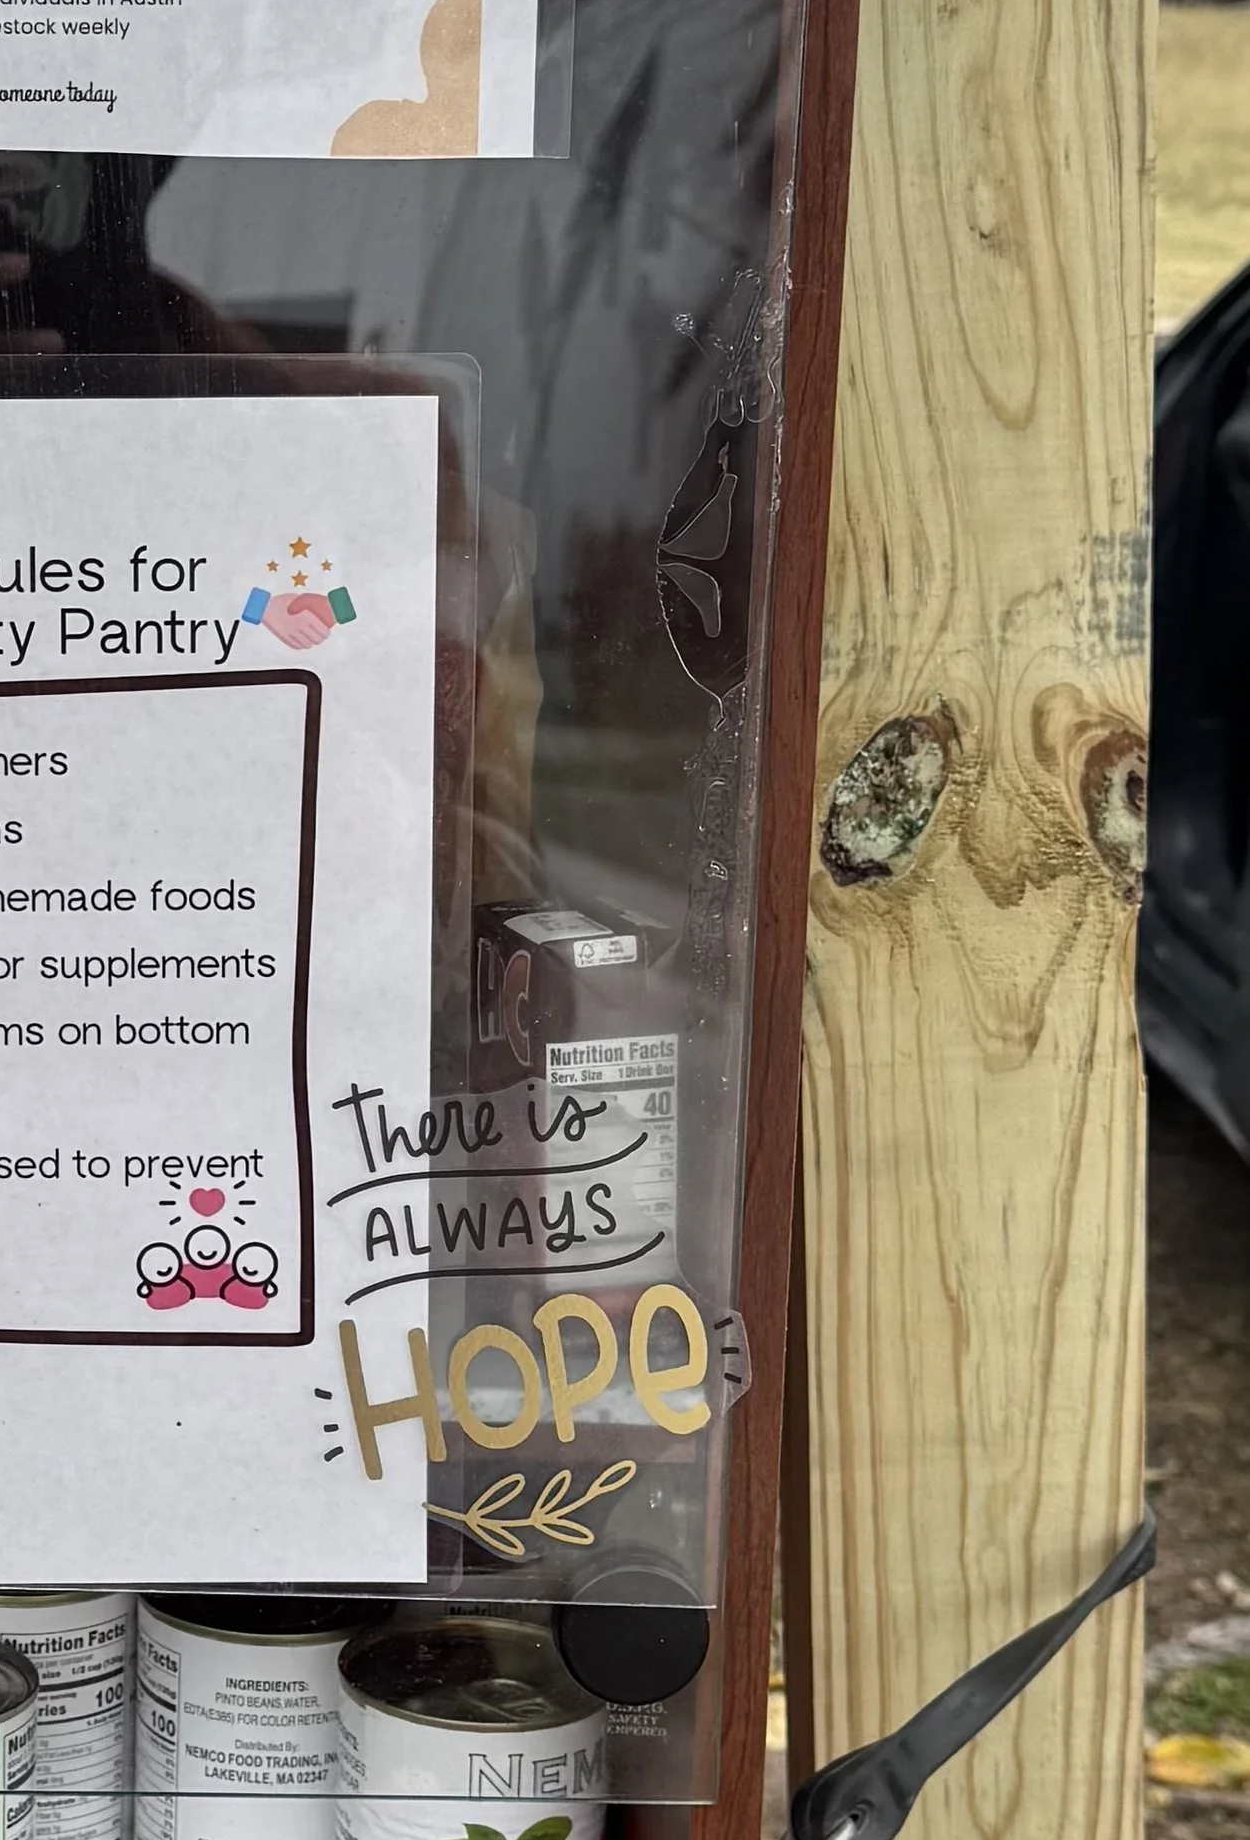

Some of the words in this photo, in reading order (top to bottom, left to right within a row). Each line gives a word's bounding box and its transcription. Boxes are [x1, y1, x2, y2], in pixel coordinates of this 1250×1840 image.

[61, 17, 131, 40] weekly
[64, 80, 118, 113] today
[130, 545, 207, 593] for
[59, 607, 241, 665] Pantry
[149, 878, 256, 911] foods
[40, 946, 277, 987] supplements
[57, 1022, 103, 1046] on
[115, 1013, 251, 1046] bottom
[549, 1043, 625, 1067] Nutrition
[629, 1039, 674, 1059] Facts
[550, 1070, 579, 1085] Serv.
[580, 1068, 603, 1082] Size
[526, 1083, 608, 1142] is
[643, 1091, 673, 1116] 40
[72, 1150, 111, 1180] to
[122, 1150, 264, 1187] prevent
[88, 1623, 126, 1647] Facts
[145, 1641, 178, 1674] Facts
[225, 1677, 310, 1693] INGREDIENTS:
[38, 1704, 67, 1718] ries
[95, 1682, 124, 1708] 100
[215, 1692, 245, 1708] PINTO
[150, 1711, 176, 1737] 100
[237, 1713, 259, 1726] FOR
[260, 1713, 296, 1728] COLOR
[185, 1743, 227, 1764] NEMCO
[228, 1754, 264, 1768] FOOD
[235, 1739, 280, 1752] Distributed
[204, 1766, 274, 1786] LAKEVILLE,
[276, 1772, 295, 1784] MA
[296, 1769, 329, 1784] 02347
